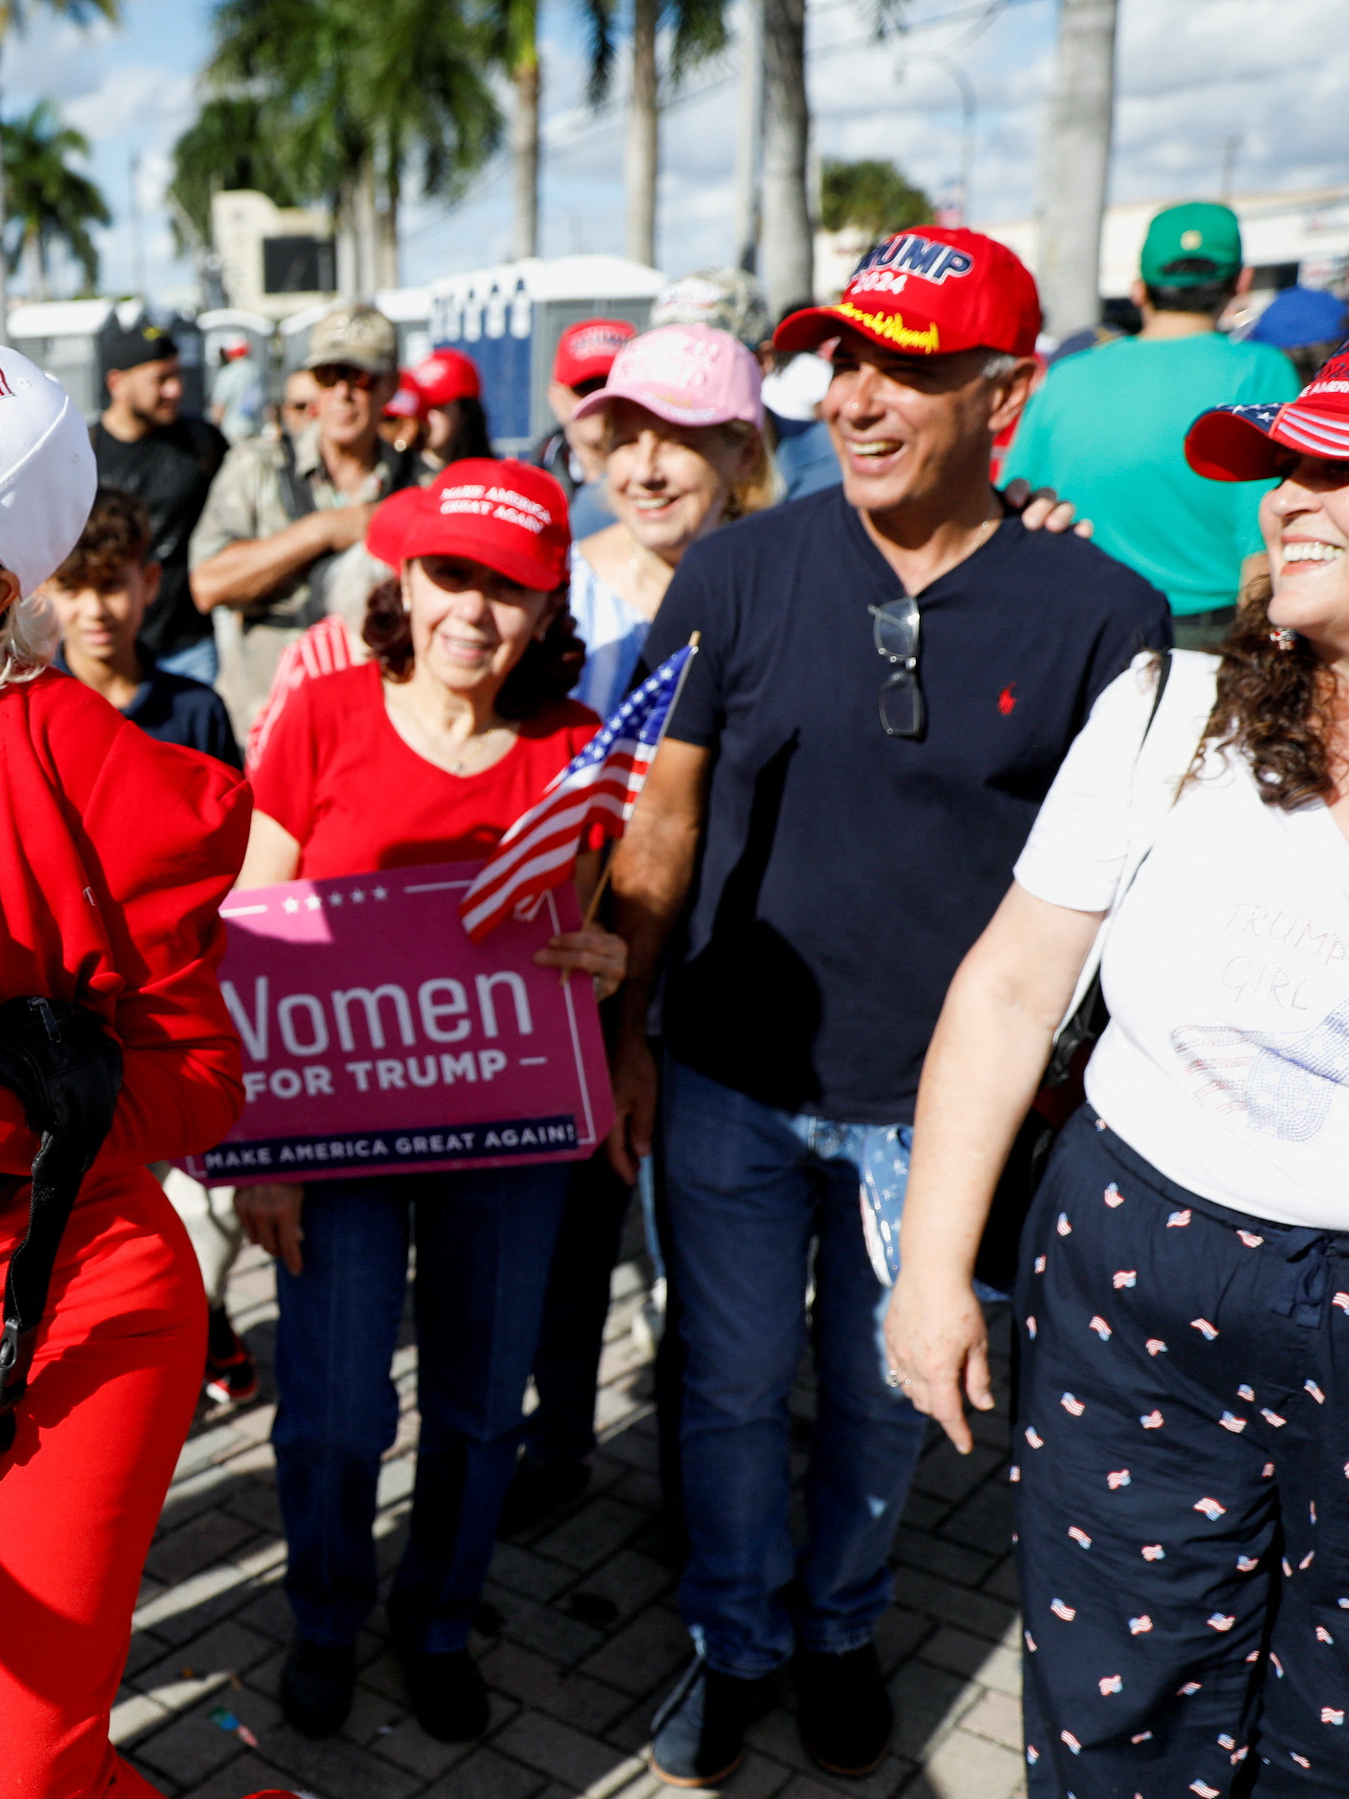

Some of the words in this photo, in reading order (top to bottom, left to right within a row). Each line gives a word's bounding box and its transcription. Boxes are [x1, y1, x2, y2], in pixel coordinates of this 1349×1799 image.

[851, 234, 974, 286] RUMP
[851, 271, 908, 295] 2024
[1308, 380, 1349, 396] AMER
[440, 485, 485, 501] MAKE
[485, 486, 552, 526] AMERICA
[1224, 902, 1346, 967] TRUMP
[1221, 954, 1309, 1011] GIRL
[242, 1064, 334, 1103] FOR
[346, 1049, 508, 1092] TRUMP
[205, 1146, 273, 1171] MAKE
[279, 1138, 390, 1163] AMERICA
[395, 1131, 476, 1156] GREAT
[484, 1123, 576, 1150] AGAIN!
